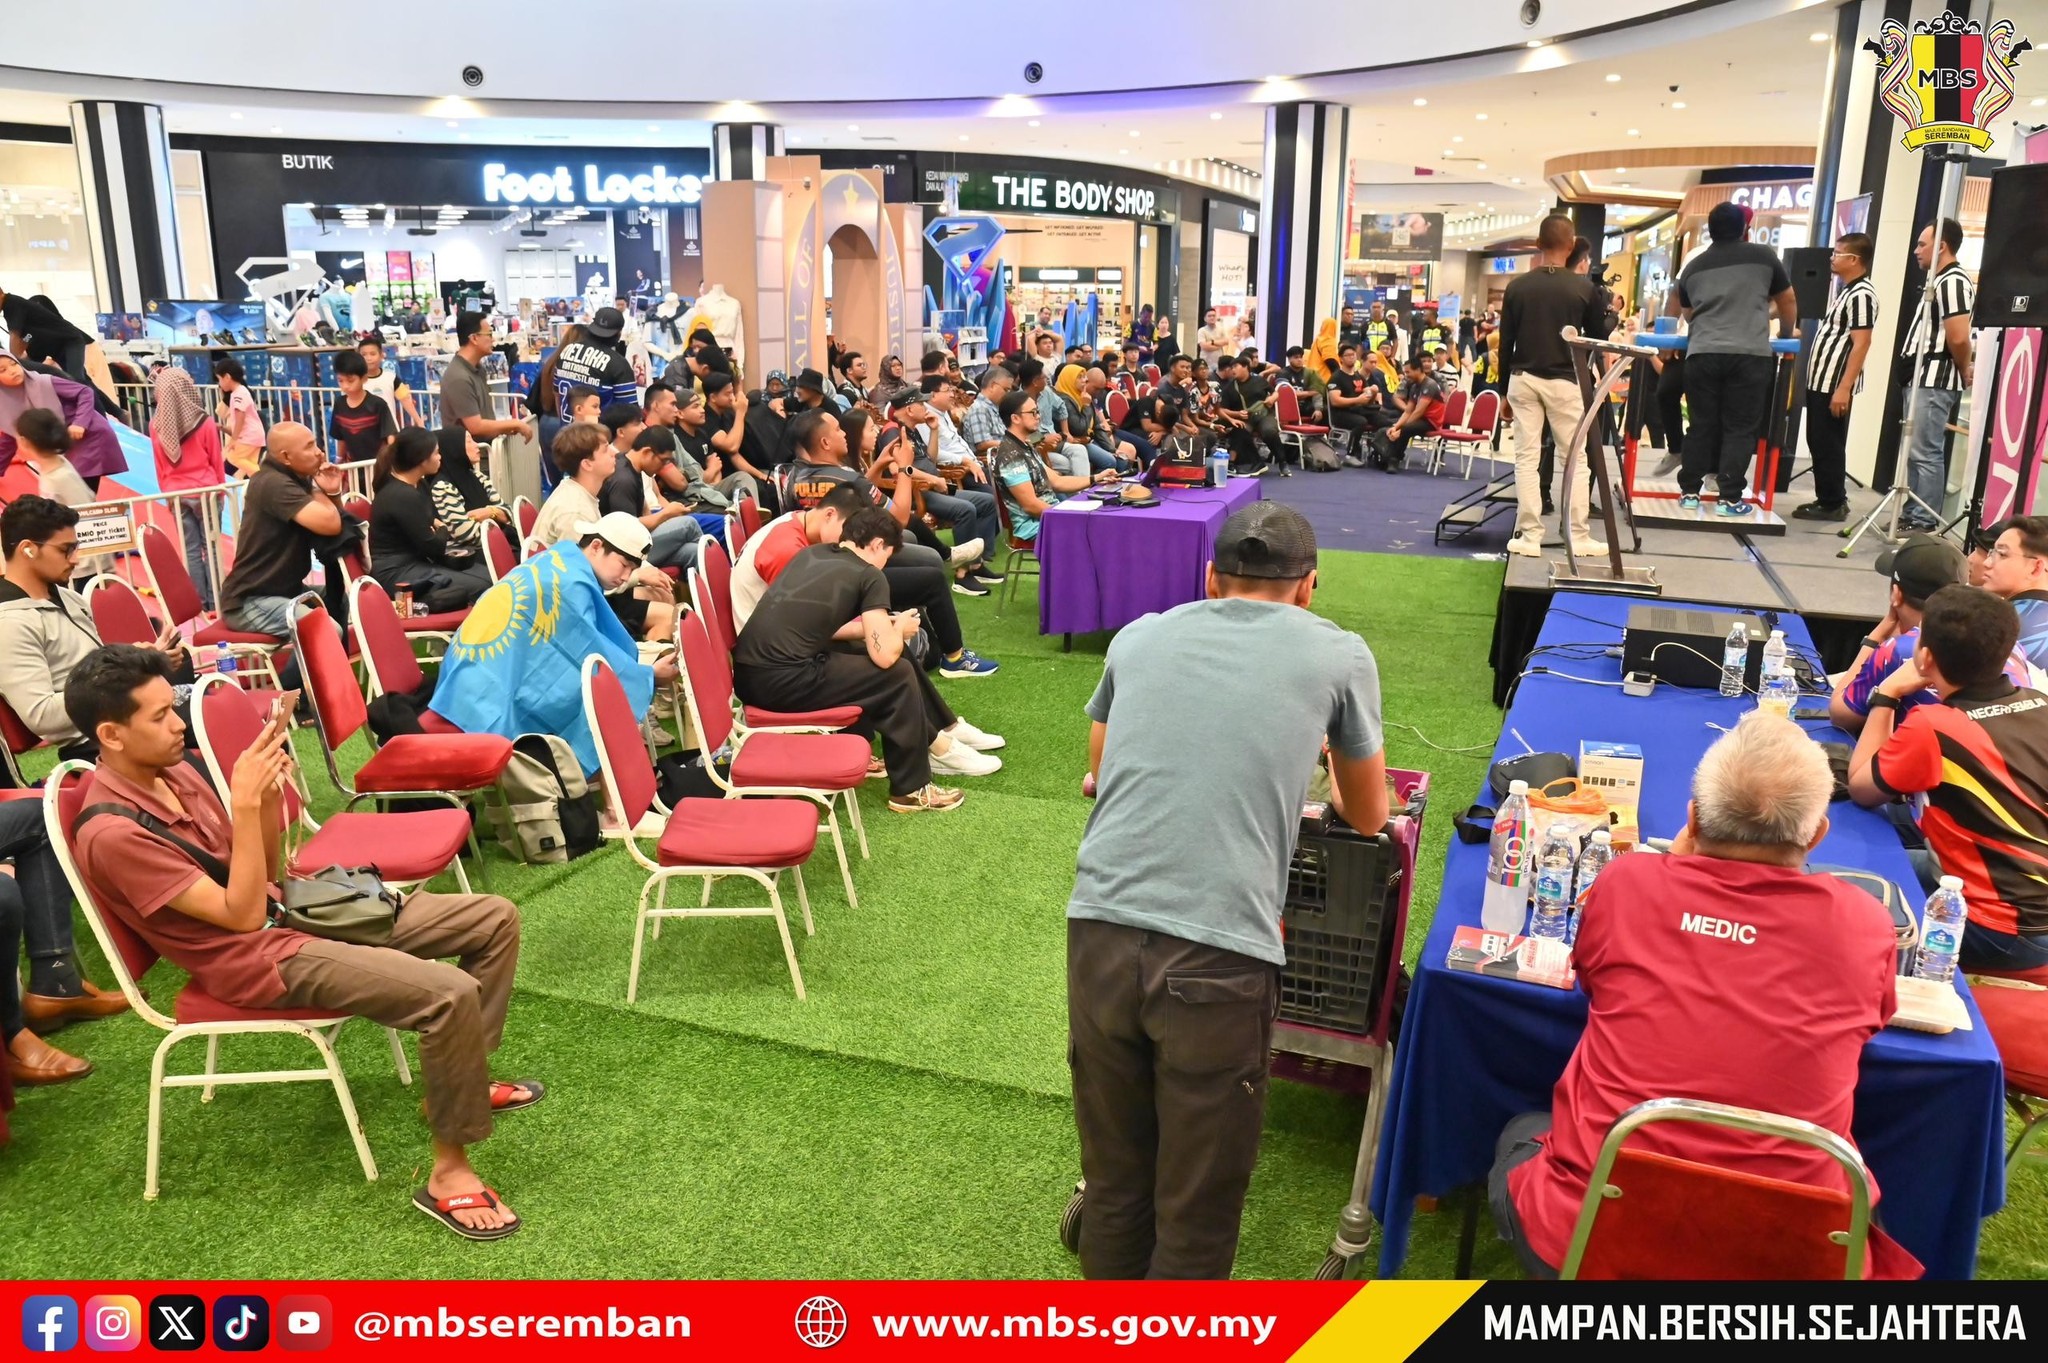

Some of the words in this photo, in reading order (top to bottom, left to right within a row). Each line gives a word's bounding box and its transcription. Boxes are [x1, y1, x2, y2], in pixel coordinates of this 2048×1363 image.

[282, 154, 333, 169] BUTIK
[483, 163, 574, 202] Foot
[585, 164, 713, 202] Locke
[992, 176, 1047, 208] THE
[1055, 180, 1112, 212] BODY
[1115, 185, 1154, 216] SHOP
[797, 238, 813, 289] OF
[1680, 912, 1757, 944] MEDIC
